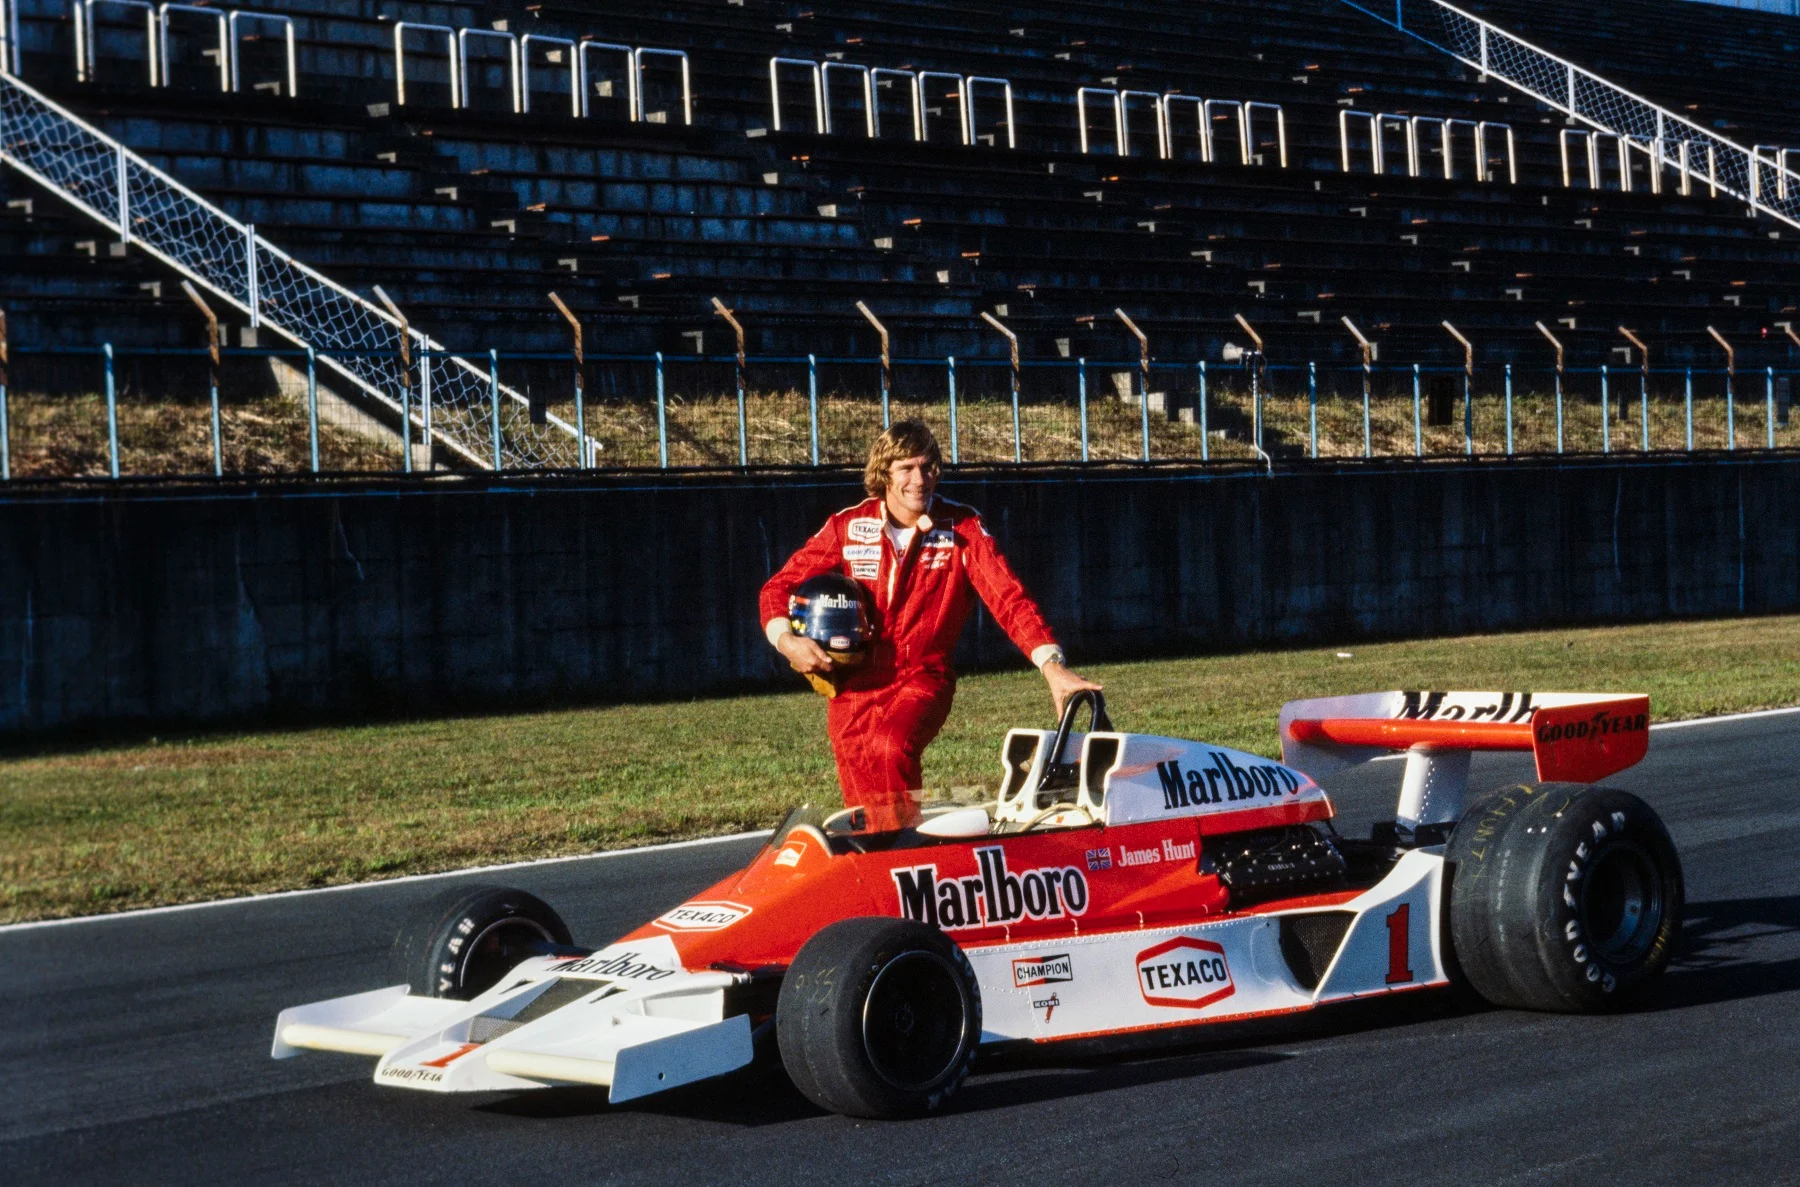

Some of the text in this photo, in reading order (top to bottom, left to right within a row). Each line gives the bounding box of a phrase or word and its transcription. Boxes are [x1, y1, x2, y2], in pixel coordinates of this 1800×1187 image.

[1394, 691, 1542, 723] Marlb
[1156, 751, 1299, 810] Marlboro
[1117, 838, 1196, 867] James Hunt
[892, 846, 1087, 930] Marlboro
[668, 908, 739, 924] TEXACO
[1385, 902, 1413, 985] 1
[544, 951, 677, 981] Marlboro
[1016, 961, 1070, 980] CHAMPION
[1141, 956, 1228, 990] TEXACO
[1034, 1000, 1059, 1008] KONI
